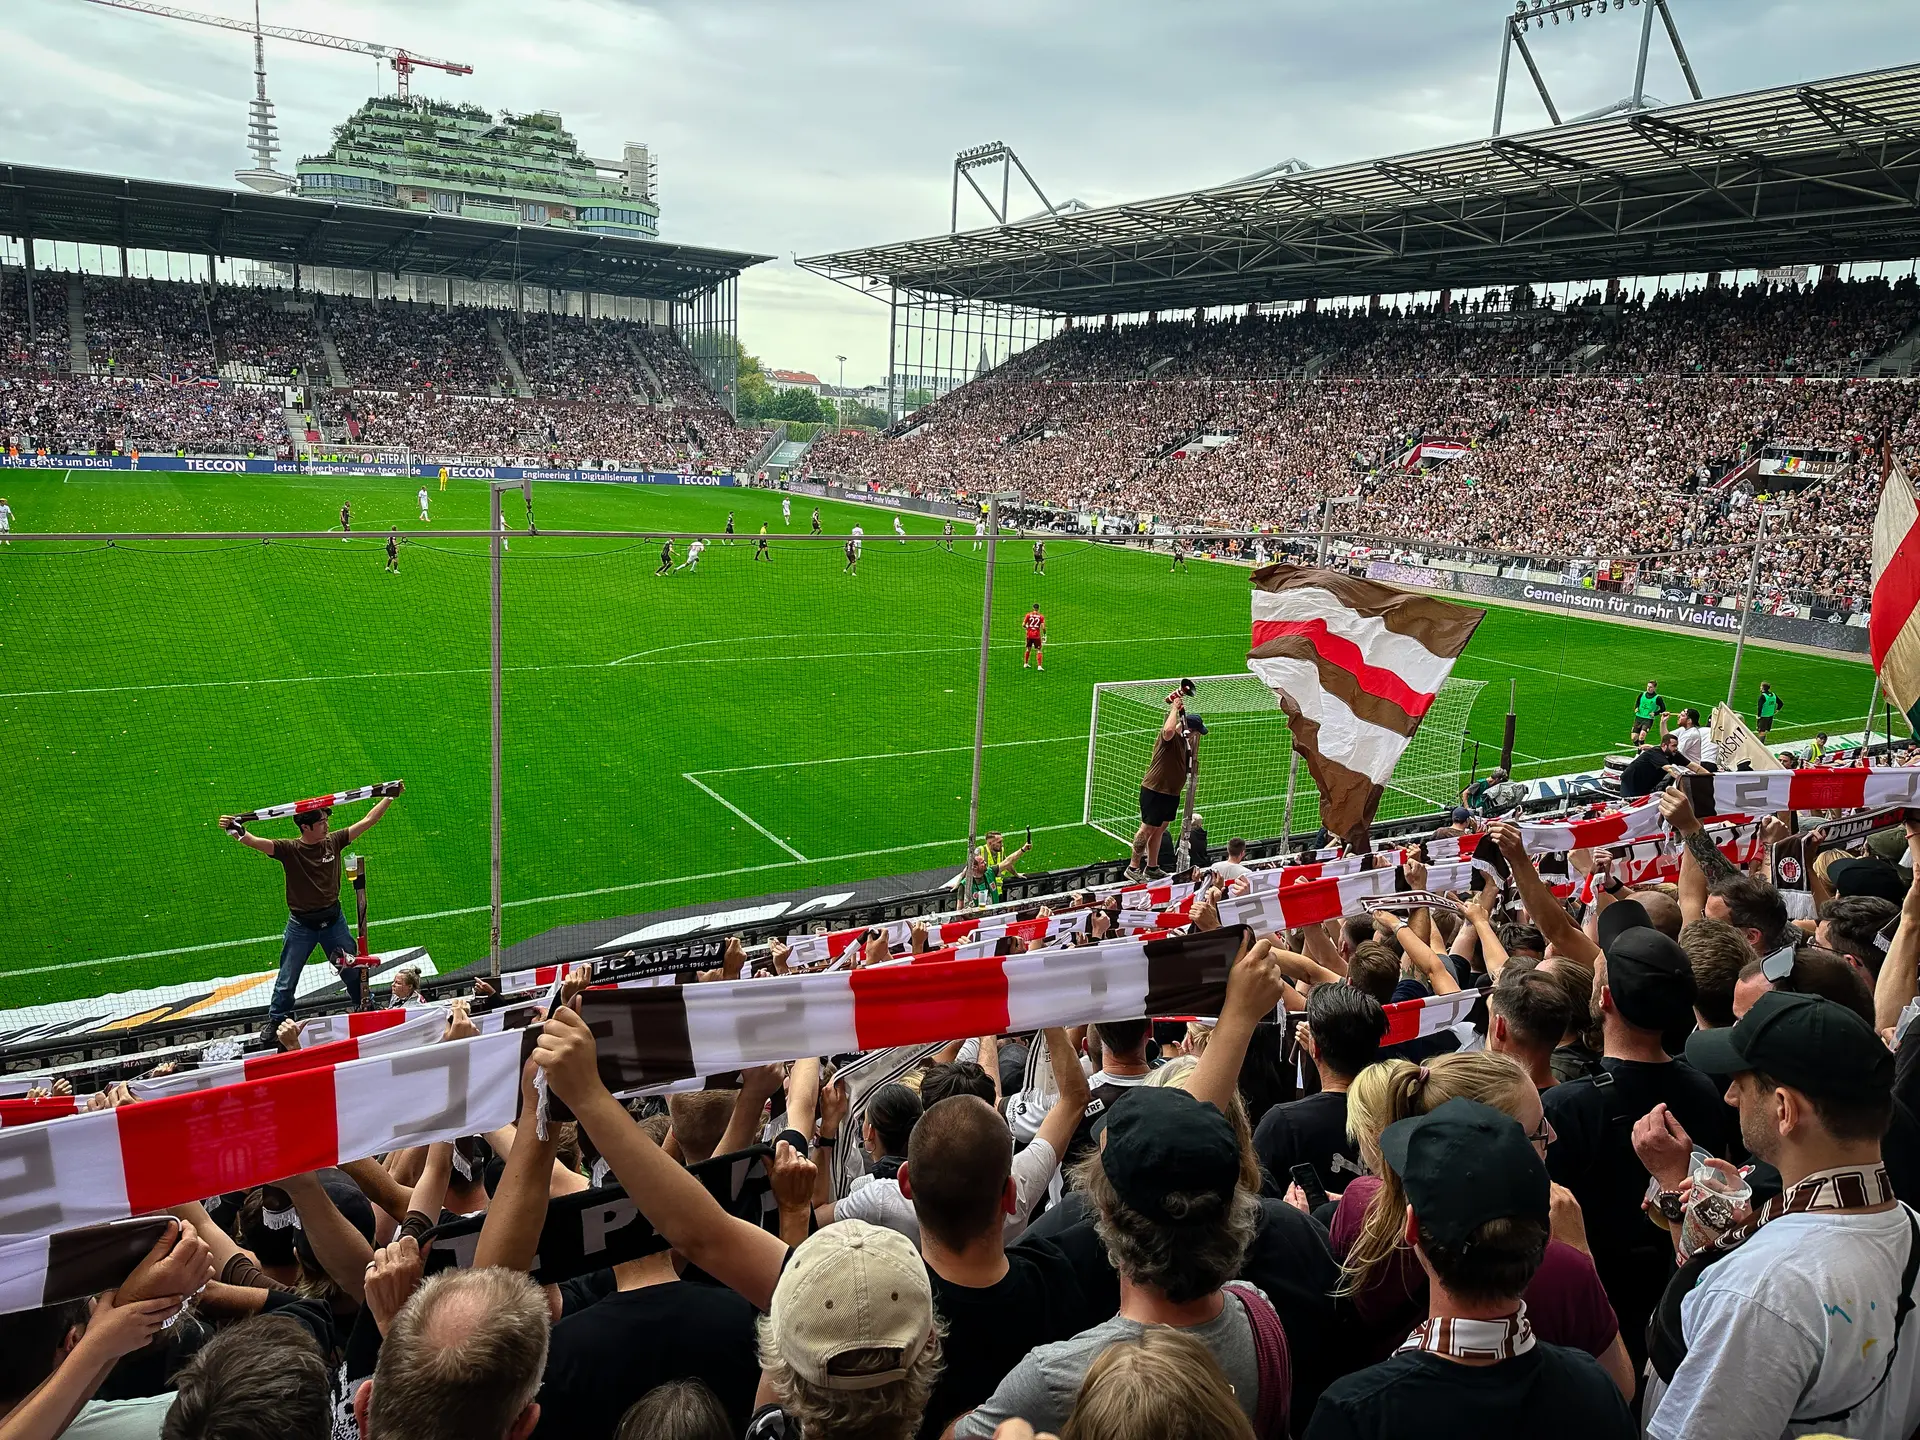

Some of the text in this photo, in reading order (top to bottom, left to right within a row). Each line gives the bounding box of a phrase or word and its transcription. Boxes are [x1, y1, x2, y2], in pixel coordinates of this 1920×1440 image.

[66, 459, 82, 467] um
[85, 458, 113, 467] Dich!
[185, 459, 247, 472] TECCON
[273, 463, 297, 473] Jetzt
[352, 465, 422, 475] www.tecconde
[523, 470, 570, 480] Engineering
[581, 472, 638, 483] Digitalisierung
[677, 475, 720, 486] TECCON
[1524, 585, 1742, 630] Gemeinsam für mehr Vielfalt.
[1029, 617, 1040, 628] 22
[593, 942, 721, 976] FC KIFFEN
